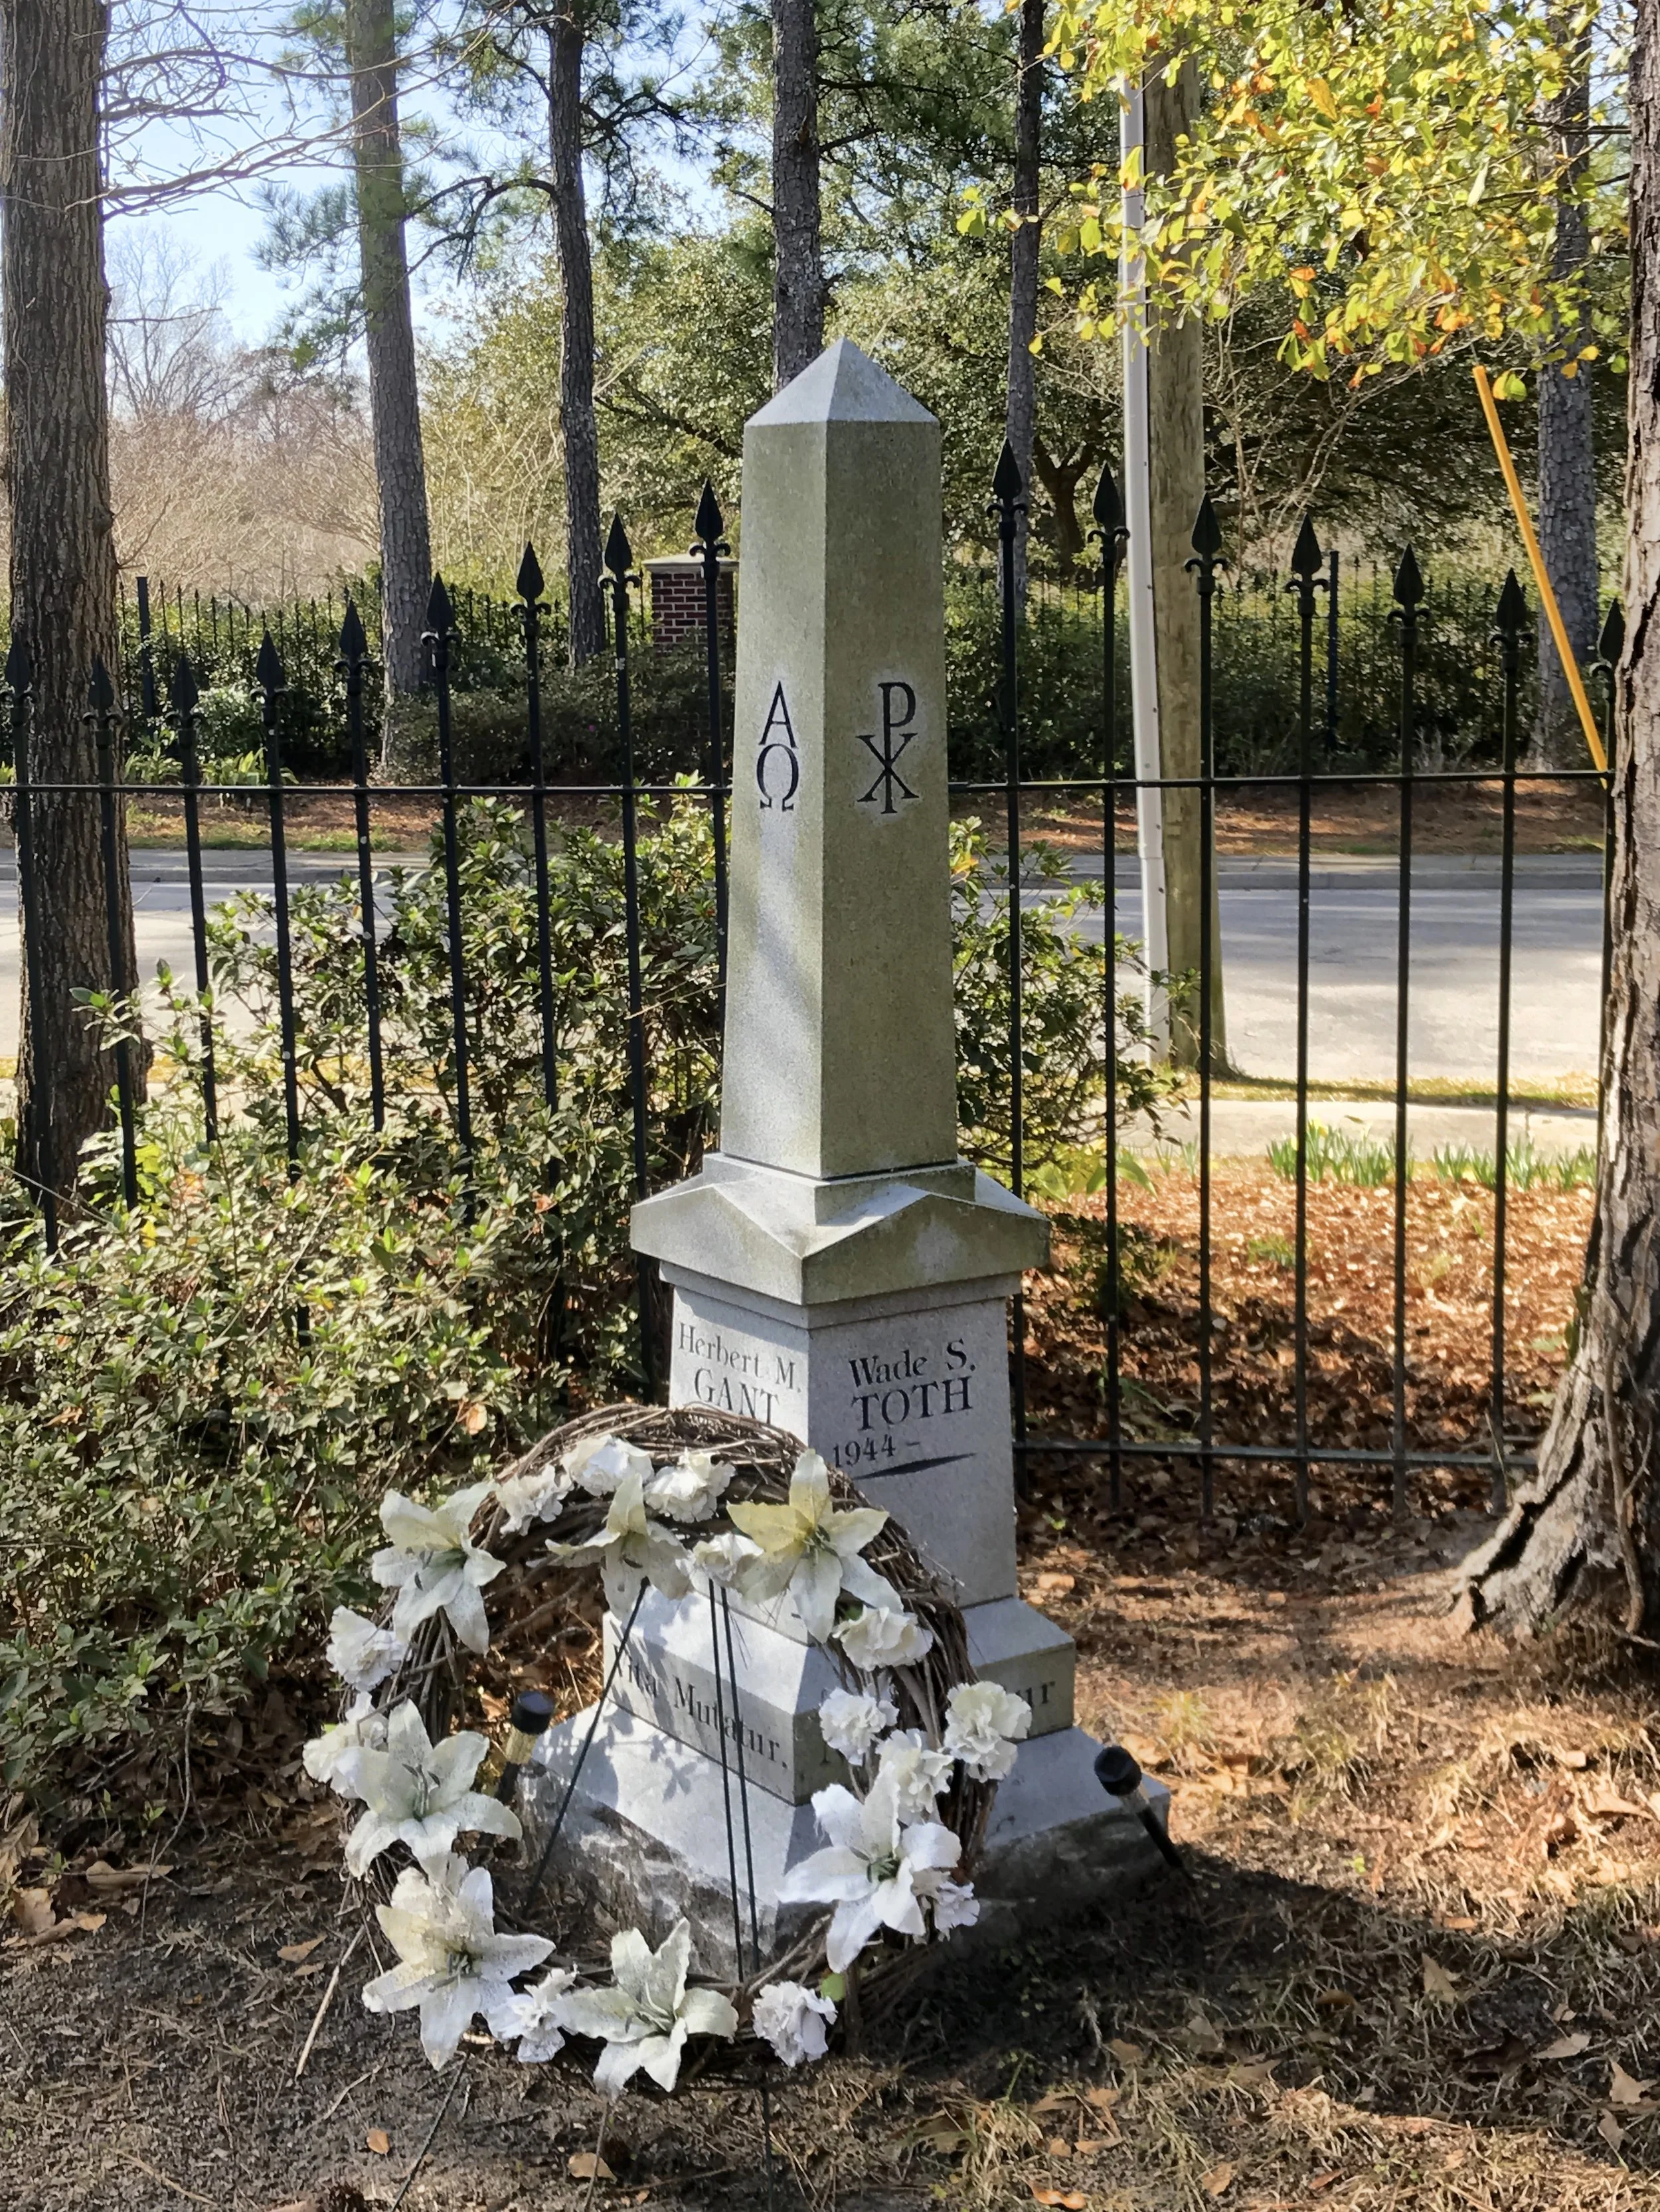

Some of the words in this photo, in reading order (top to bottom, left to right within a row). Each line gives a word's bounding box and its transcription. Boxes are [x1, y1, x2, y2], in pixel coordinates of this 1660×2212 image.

[678, 1322, 763, 1379] Herbert
[775, 1356, 802, 1393] M.
[848, 1349, 928, 1388] Wade
[945, 1338, 977, 1372] S.
[694, 1367, 780, 1425] GANT
[851, 1376, 973, 1431] TOTH
[833, 1434, 896, 1468] 1944
[673, 1674, 788, 1770] Mutaur.
